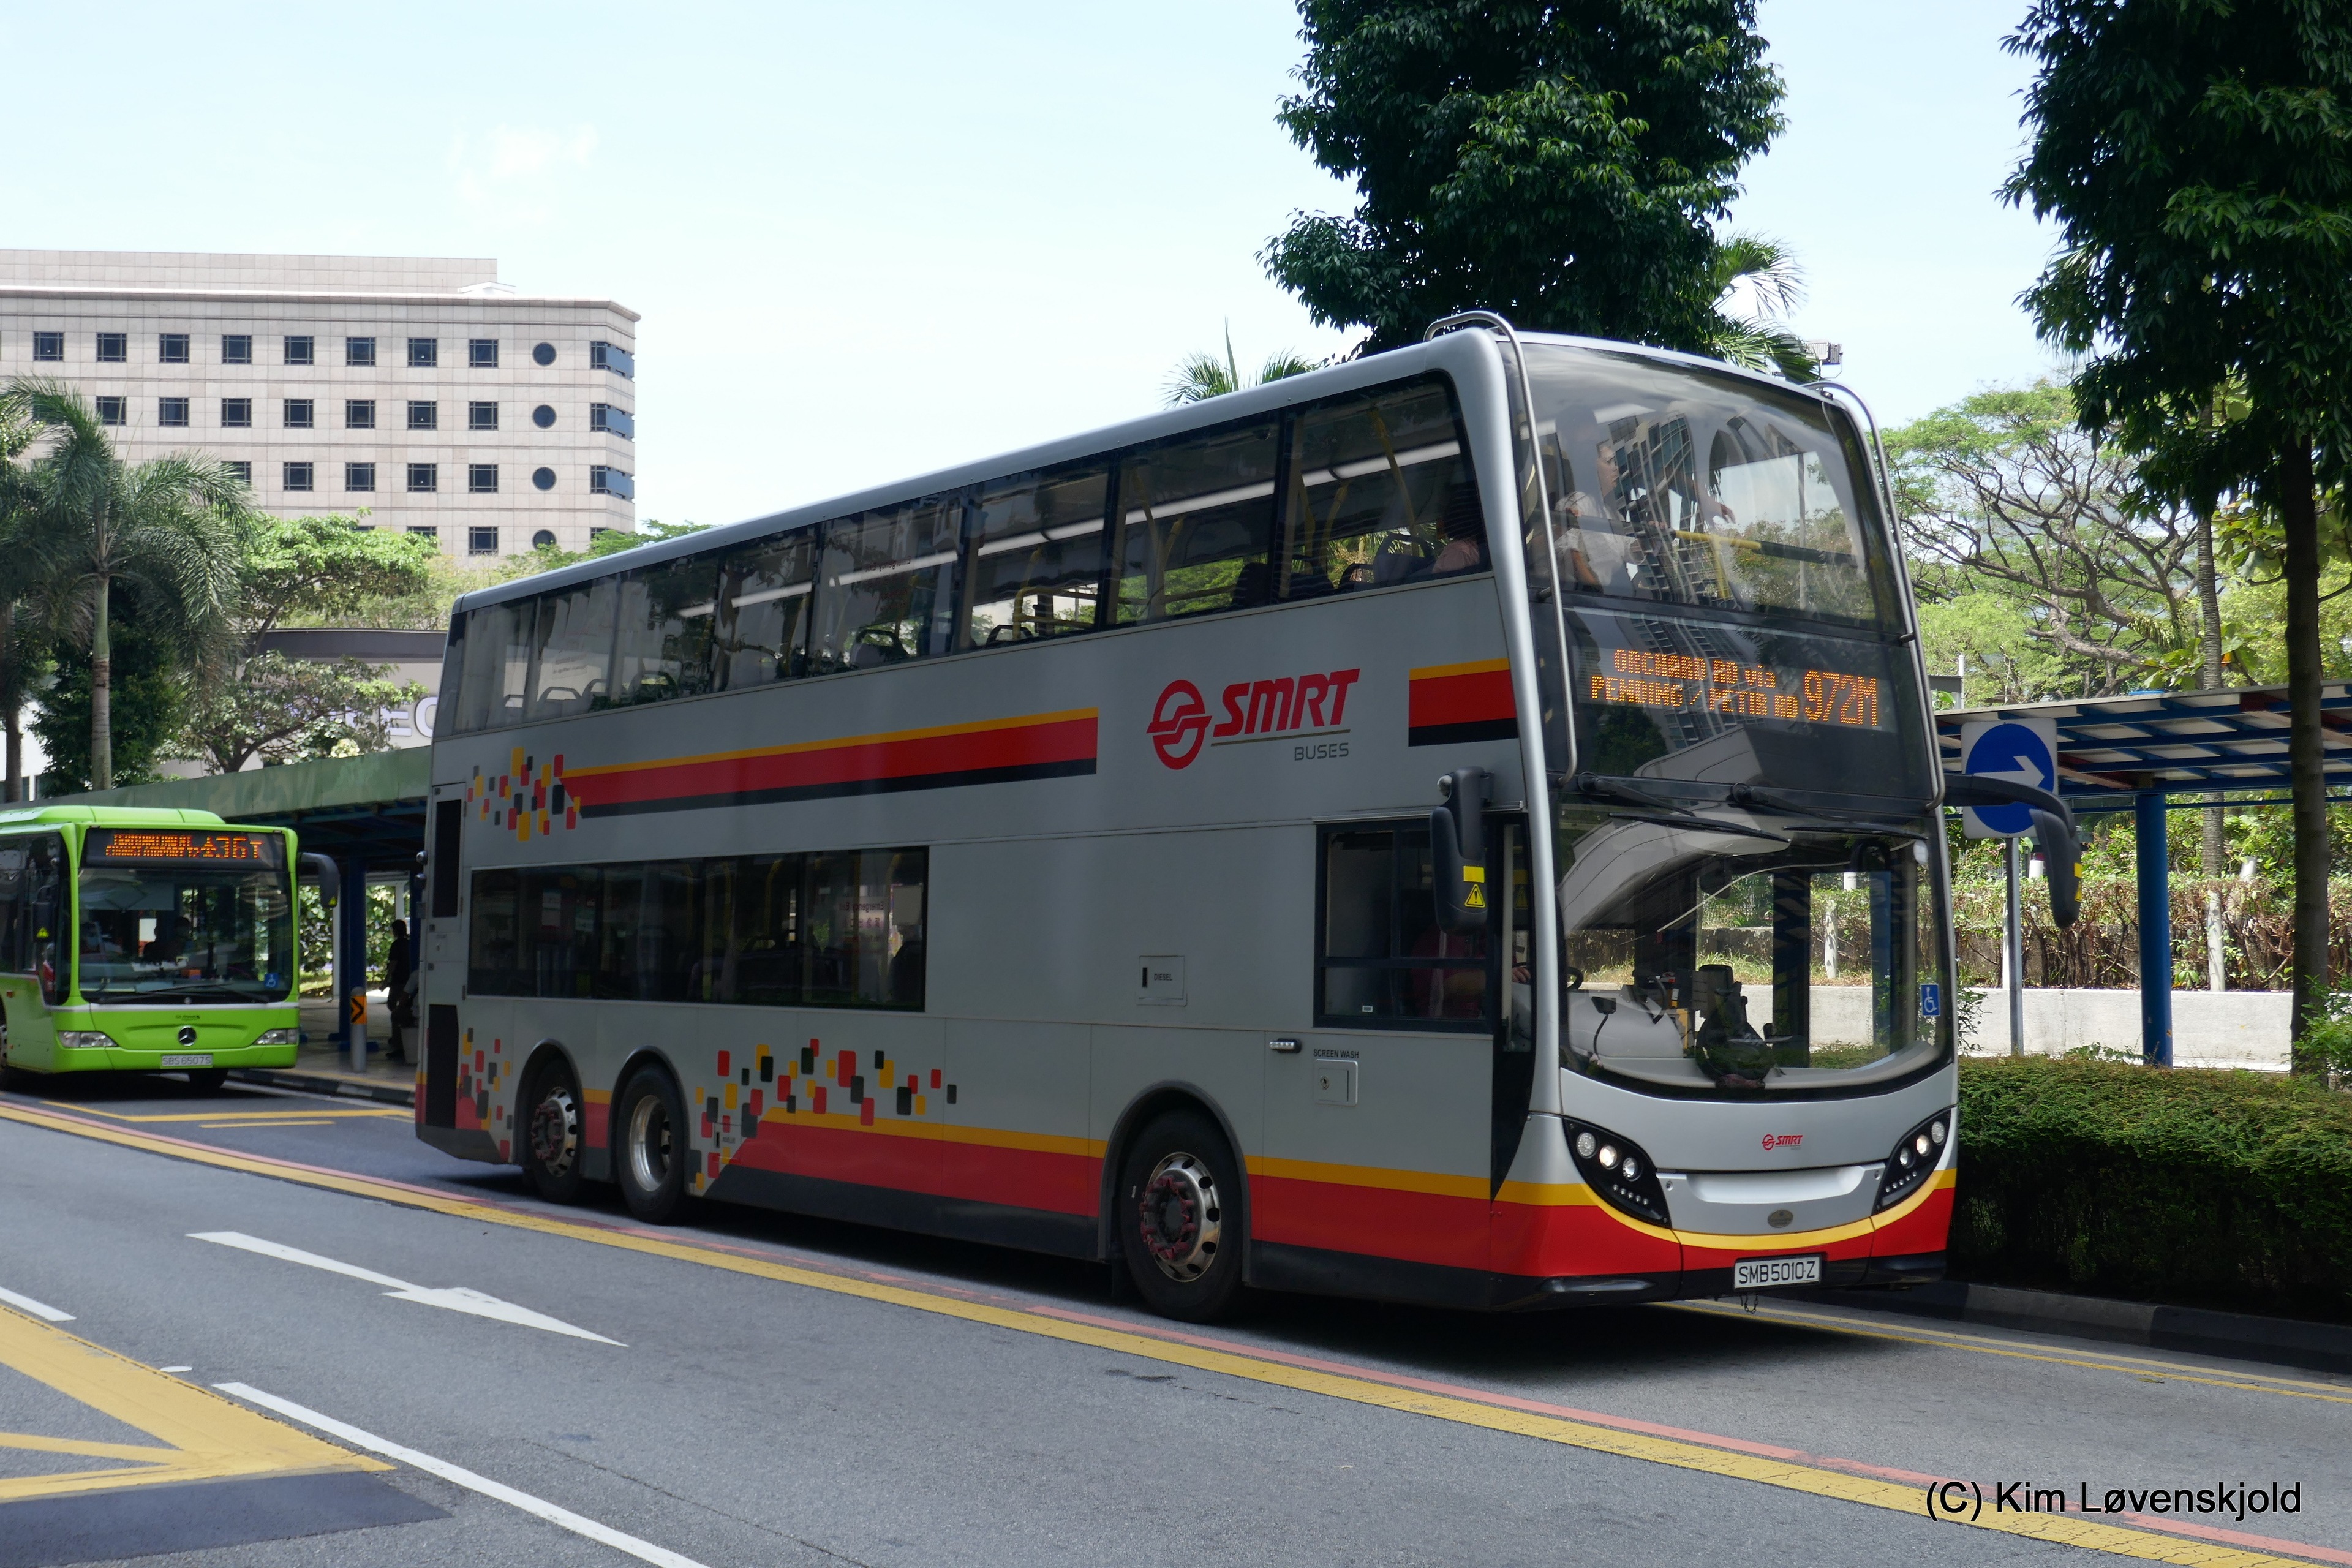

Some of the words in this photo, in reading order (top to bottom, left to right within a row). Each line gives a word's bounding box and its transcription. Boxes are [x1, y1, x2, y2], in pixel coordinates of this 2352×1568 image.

[1614, 649, 1706, 680] ORCHARD
[1713, 659, 1738, 684] RD
[1744, 665, 1776, 688] via
[1213, 668, 1360, 737] SMRT
[1591, 676, 1683, 707] PENDING
[1709, 688, 1768, 715] PETIR
[1774, 695, 1798, 718] RD
[1804, 670, 1877, 726] 972M
[1294, 742, 1349, 761] BUSES
[216, 837, 263, 858] 36T
[162, 1057, 211, 1065] SBS6507S
[1313, 1049, 1338, 1058] SCREEN
[1340, 1050, 1359, 1058] WASH
[1776, 1135, 1803, 1145] SMRT
[1738, 1261, 1815, 1284] SMB5010Z
